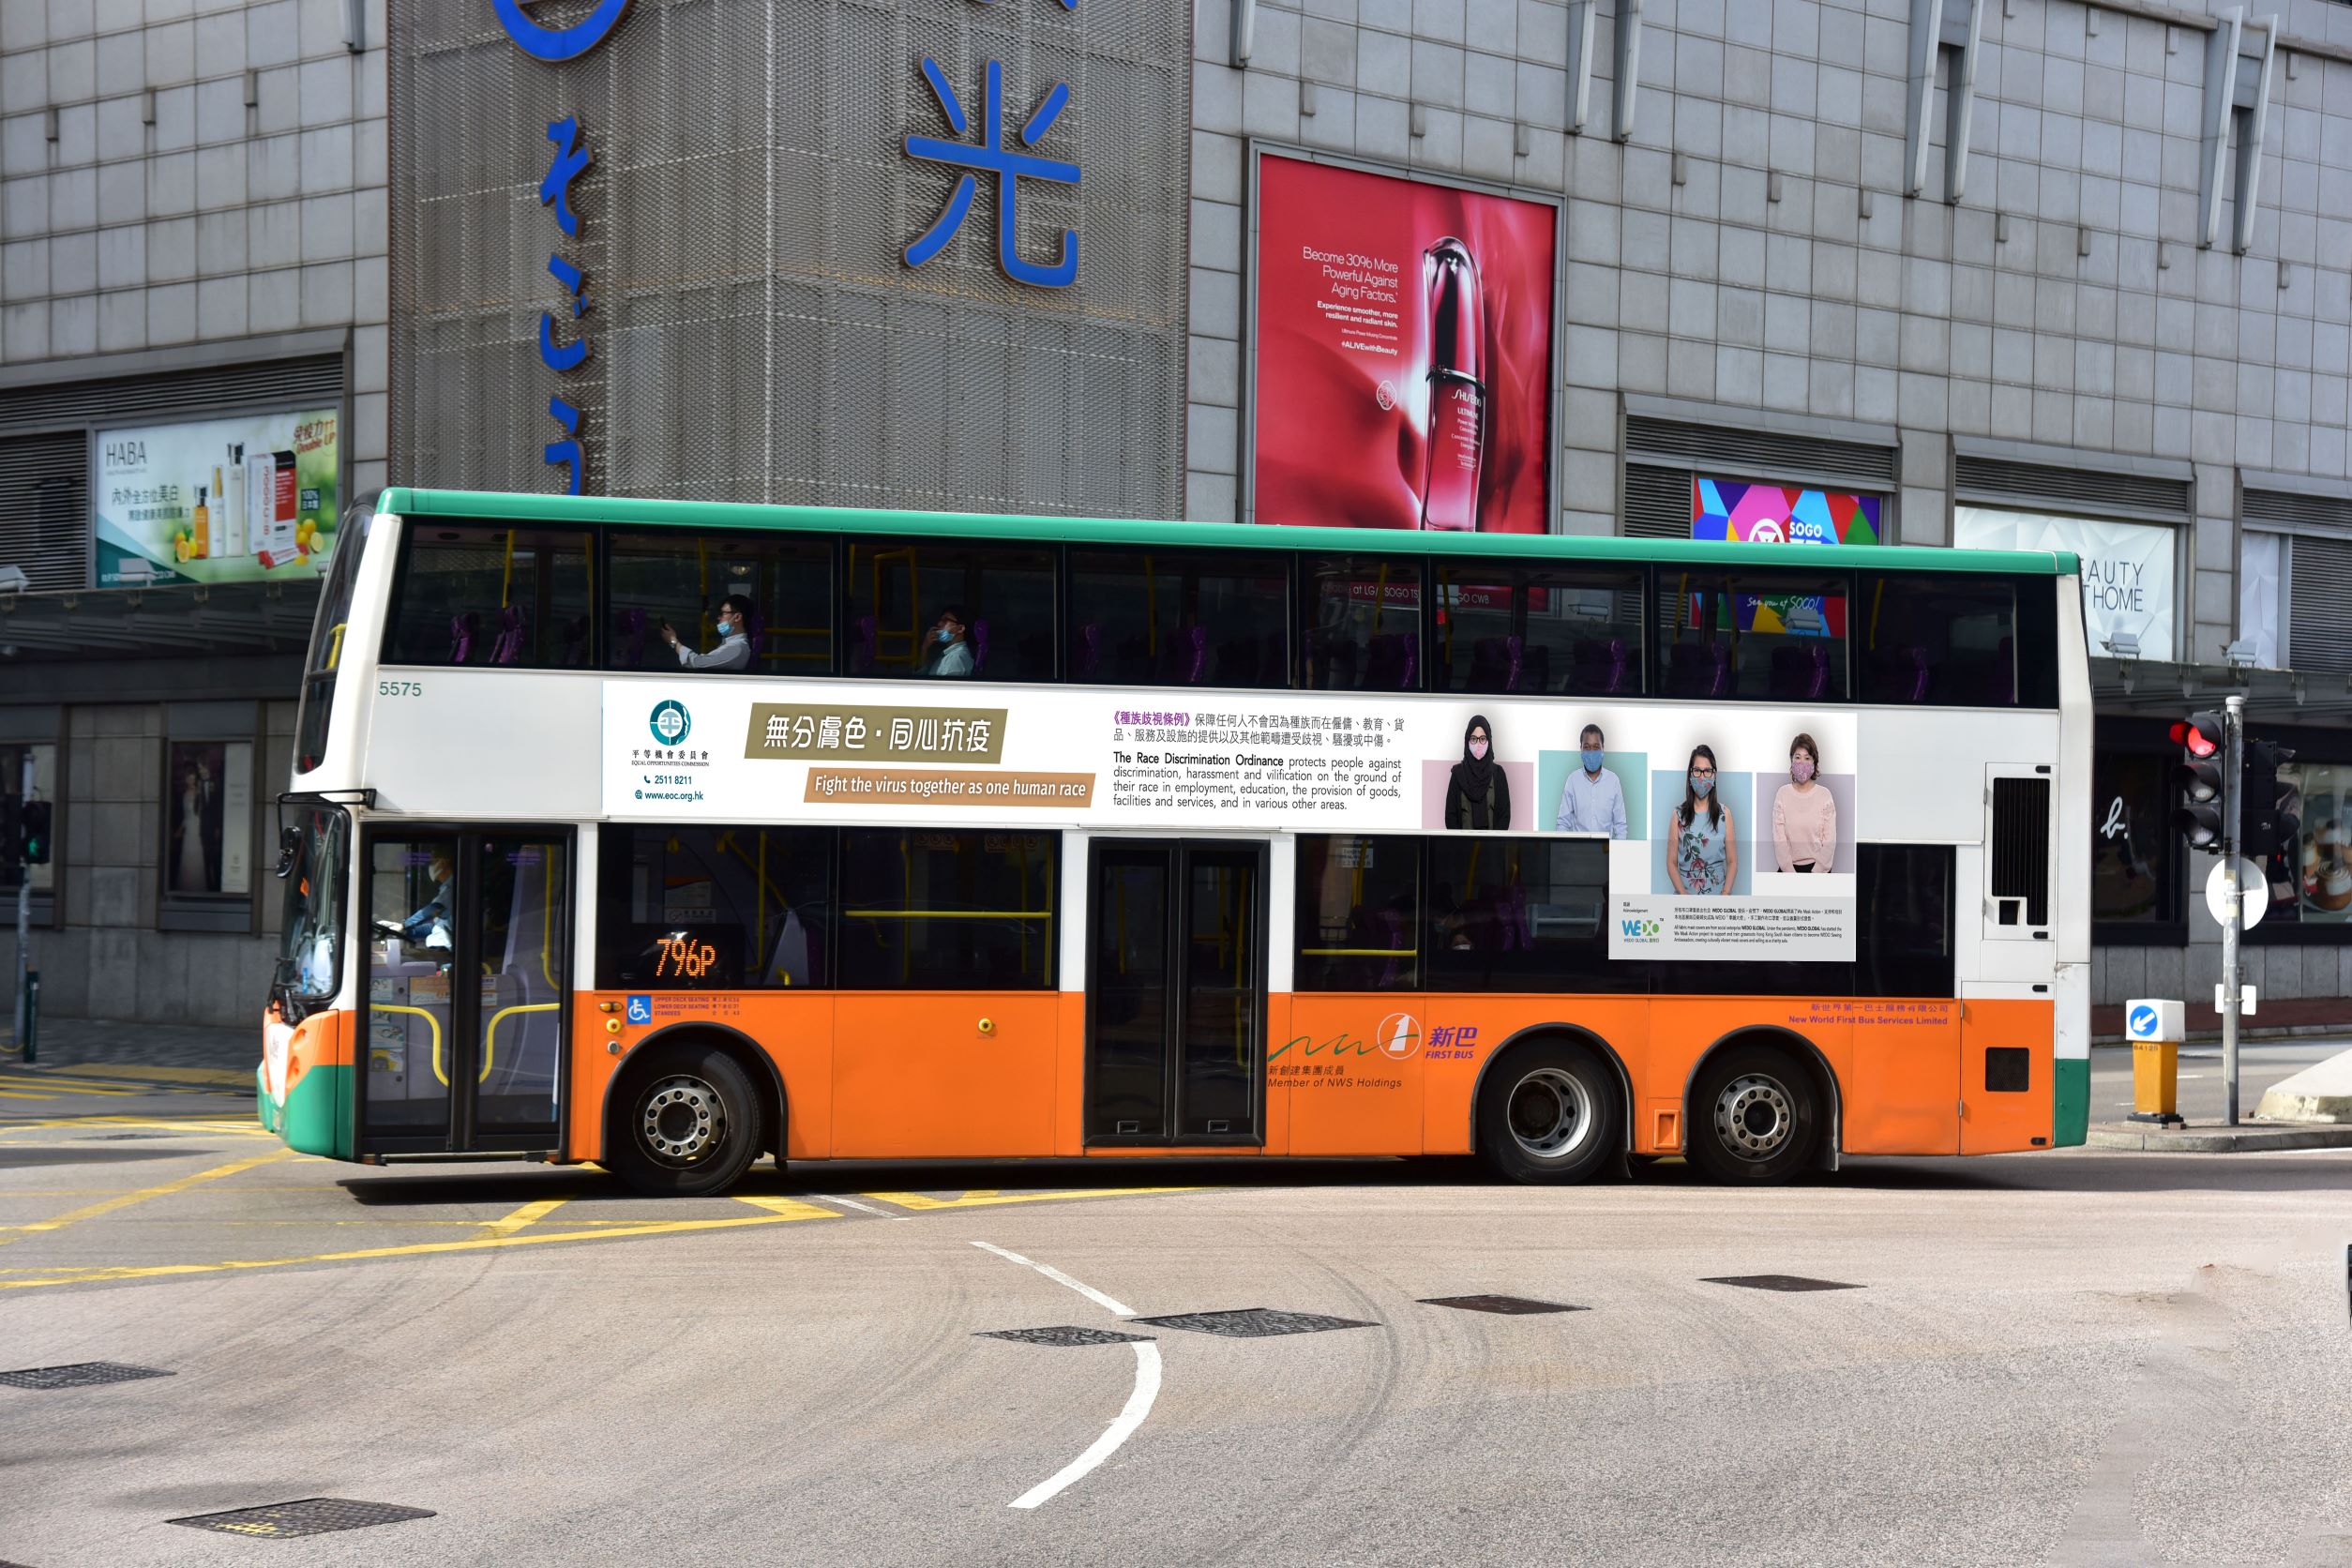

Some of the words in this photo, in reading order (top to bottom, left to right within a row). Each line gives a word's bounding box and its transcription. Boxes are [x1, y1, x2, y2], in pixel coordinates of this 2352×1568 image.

[1303, 246, 1345, 264] Become
[1346, 253, 1373, 269] 30%
[1374, 258, 1398, 273] More
[1322, 264, 1363, 282] Powerful
[1364, 272, 1398, 288] Against
[1332, 282, 1359, 299] Aging
[1317, 300, 1351, 312] Experience
[1352, 307, 1381, 318] smoother,
[1326, 312, 1349, 321] resilient
[1363, 317, 1383, 326] radiant
[1341, 340, 1398, 356] #ALIVEwithBeauty
[106, 441, 147, 467] HABA
[1789, 521, 1822, 538] SOGO
[2080, 558, 2144, 586] AUTY
[1353, 586, 1362, 596] at
[1384, 586, 1409, 598] SOGO
[1471, 594, 1489, 605] CWB
[2093, 585, 2144, 612] HOME
[1747, 596, 1761, 608] See
[1764, 599, 1778, 610] you
[379, 682, 422, 697] 5575
[1113, 711, 1190, 727] 《種族歧視條例》
[632, 749, 708, 760] 平等機會委員會
[1113, 751, 1131, 763] The
[1137, 752, 1159, 763] Race
[1165, 752, 1230, 765] Discrimination
[1235, 753, 1284, 766] Ordinance
[1289, 758, 1326, 770] protects
[1332, 756, 1364, 771] people
[1368, 758, 1402, 771] against
[655, 775, 672, 784] 2511
[674, 776, 692, 785] 8211
[1113, 765, 1182, 780] discrimination,
[1186, 767, 1239, 779] harassment
[1244, 769, 1261, 780] and
[1267, 769, 1312, 781] vilification
[1317, 773, 1329, 781] on
[1334, 770, 1349, 782] the
[1354, 771, 1387, 785] ground
[1392, 771, 1402, 782] of
[815, 775, 848, 795] Fight
[851, 776, 872, 793] the
[876, 776, 907, 794] virus
[910, 778, 966, 798] together
[969, 783, 983, 795] as
[986, 783, 1009, 796] one
[1013, 781, 1056, 796] human
[1059, 784, 1086, 797] race
[1113, 780, 1135, 792] their
[1138, 783, 1158, 792] race
[1163, 781, 1170, 792] in
[1175, 781, 1236, 796] employment,
[1240, 782, 1289, 796] education,
[1292, 783, 1307, 794] the
[1311, 785, 1352, 798] provision
[1356, 784, 1366, 796] of
[1369, 786, 1401, 799] goods,
[645, 791, 703, 803] www.eoc.org.hk
[1113, 794, 1152, 807] facilities
[1154, 795, 1173, 807] and
[1177, 795, 1216, 808] services,
[1221, 796, 1239, 807] and
[1243, 797, 1251, 807] in
[1255, 797, 1288, 808] various
[1291, 797, 1317, 809] other
[1320, 801, 1348, 809] areas.
[656, 939, 716, 976] 796P
[1837, 1016, 1856, 1024] First
[1859, 1016, 1875, 1024] Bus
[1917, 1017, 1948, 1025] Limited
[1427, 1026, 1478, 1048] 新巴
[1425, 1050, 1453, 1060] FIRST
[1455, 1050, 1473, 1060] BUS
[1268, 1064, 1345, 1077] 新創建集團成員
[1268, 1078, 1310, 1088] Member
[1313, 1078, 1324, 1088] of
[1327, 1078, 1354, 1088] NWS
[1357, 1078, 1402, 1090] Holdings
